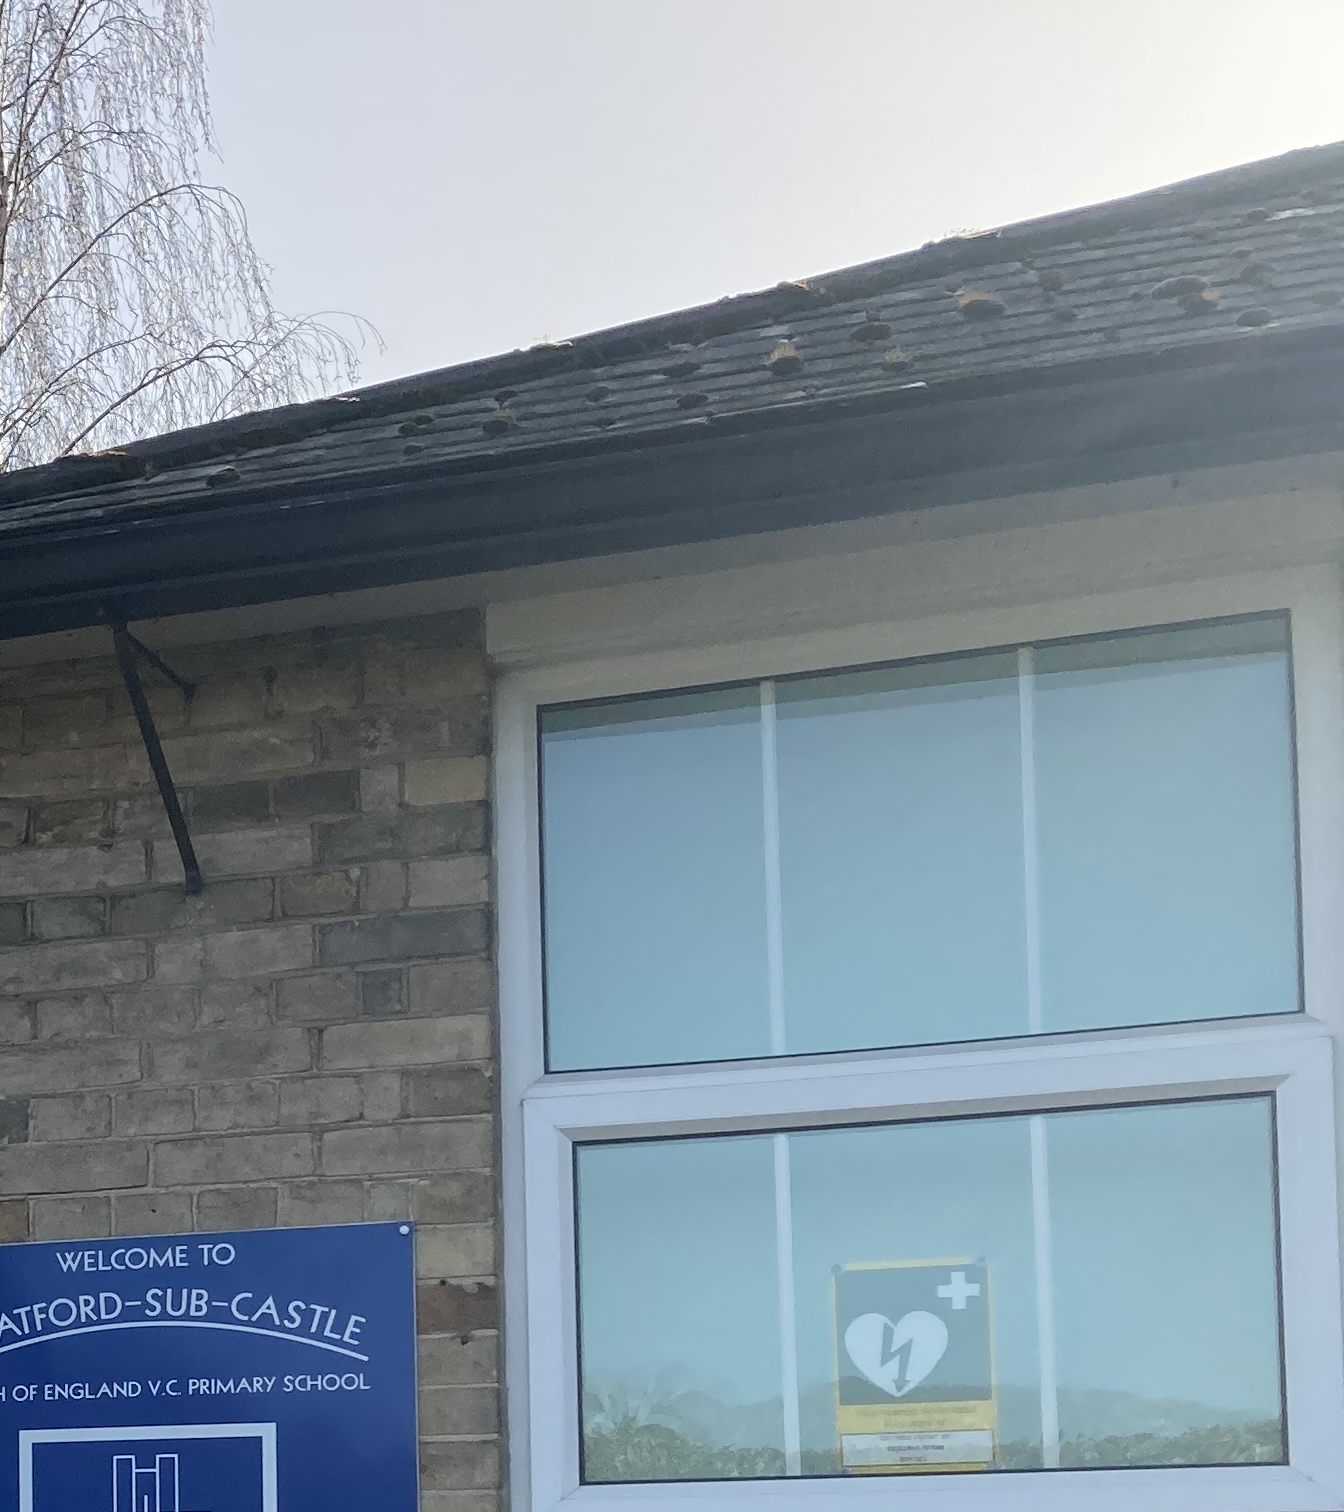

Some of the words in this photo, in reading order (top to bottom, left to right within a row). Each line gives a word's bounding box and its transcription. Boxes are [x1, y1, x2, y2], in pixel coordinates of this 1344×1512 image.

[55, 1245, 189, 1273] WELCOME
[197, 1243, 236, 1266] TO
[12, 1384, 39, 1402] OF
[44, 1380, 142, 1401] ENGLAND
[147, 1379, 182, 1397] V.C.
[188, 1376, 277, 1396] PRIMARY
[282, 1373, 371, 1393] SCHOOL
